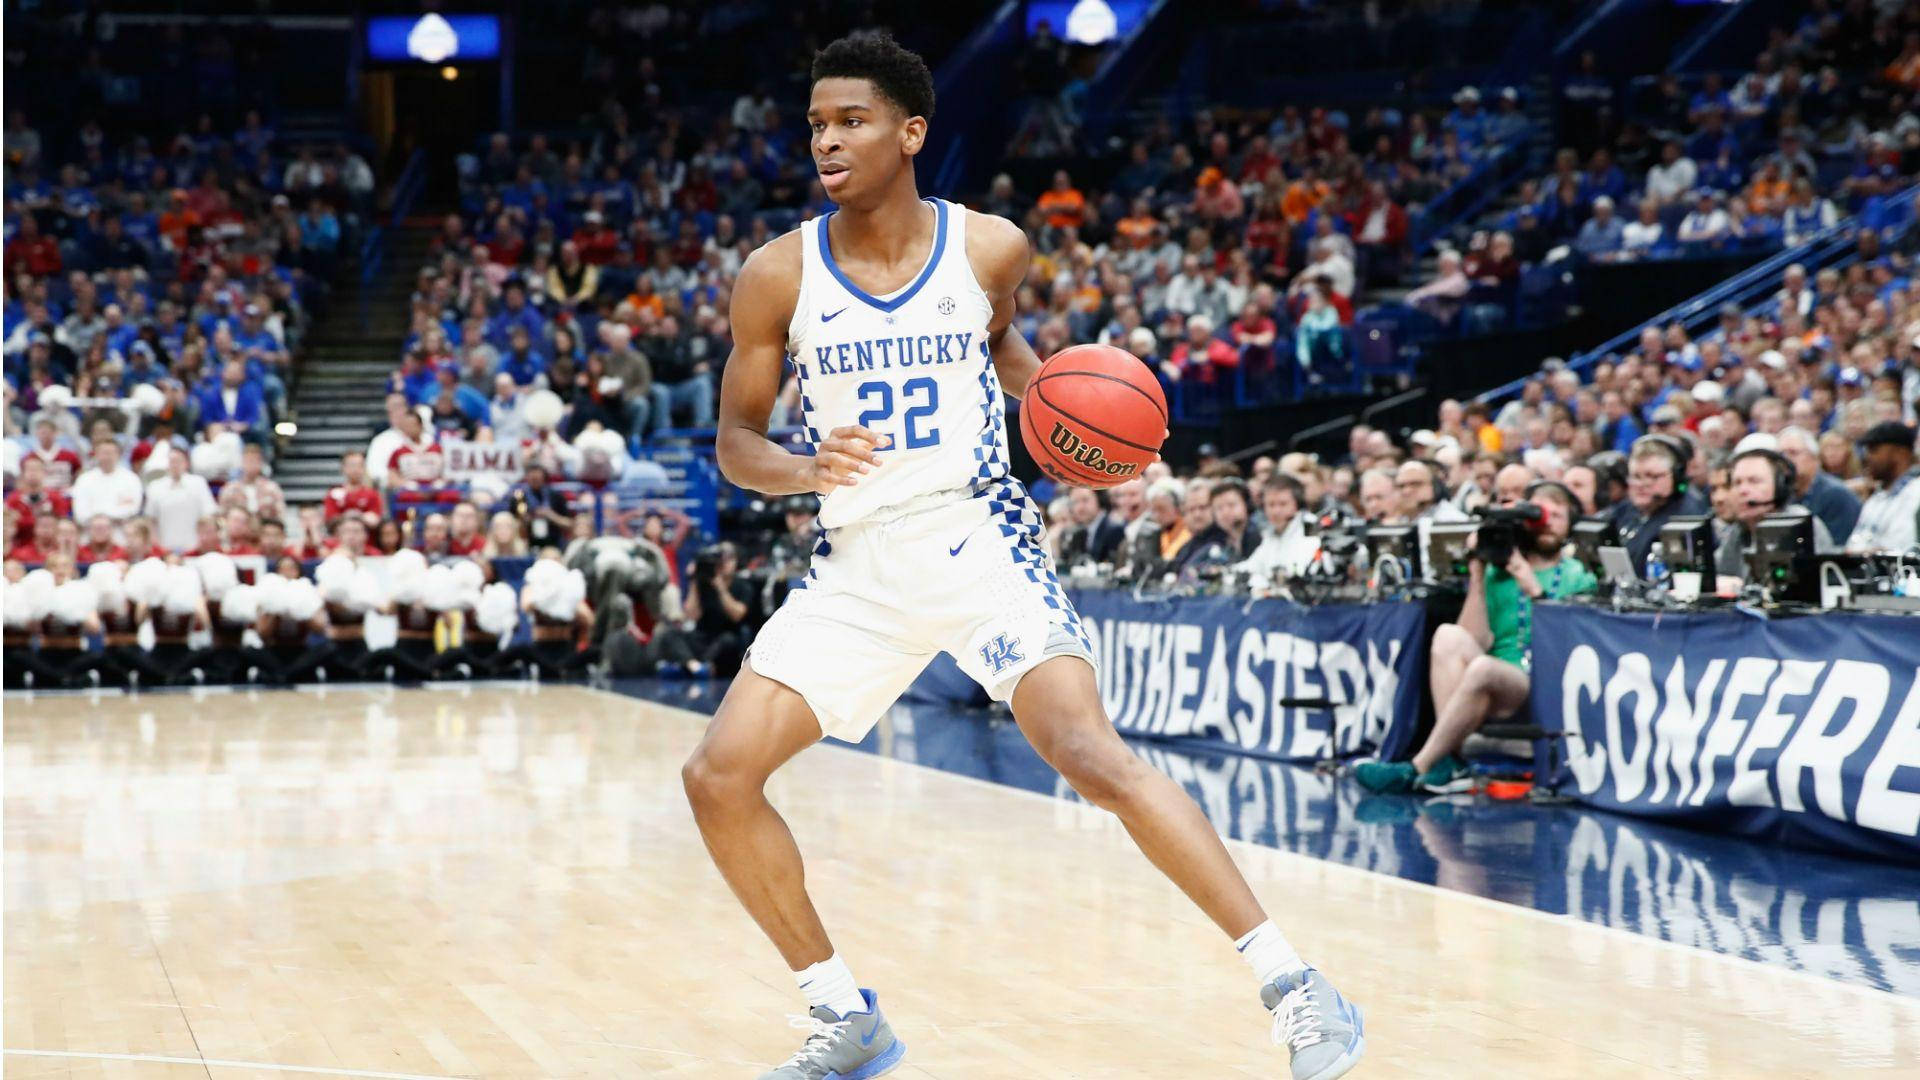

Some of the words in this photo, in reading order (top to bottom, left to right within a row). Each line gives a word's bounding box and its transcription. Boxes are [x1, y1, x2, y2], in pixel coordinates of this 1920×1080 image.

[816, 332, 973, 375] KENTUCKY
[857, 377, 941, 451] 22
[451, 448, 518, 472] BAMA
[1050, 421, 1139, 476] Wilson
